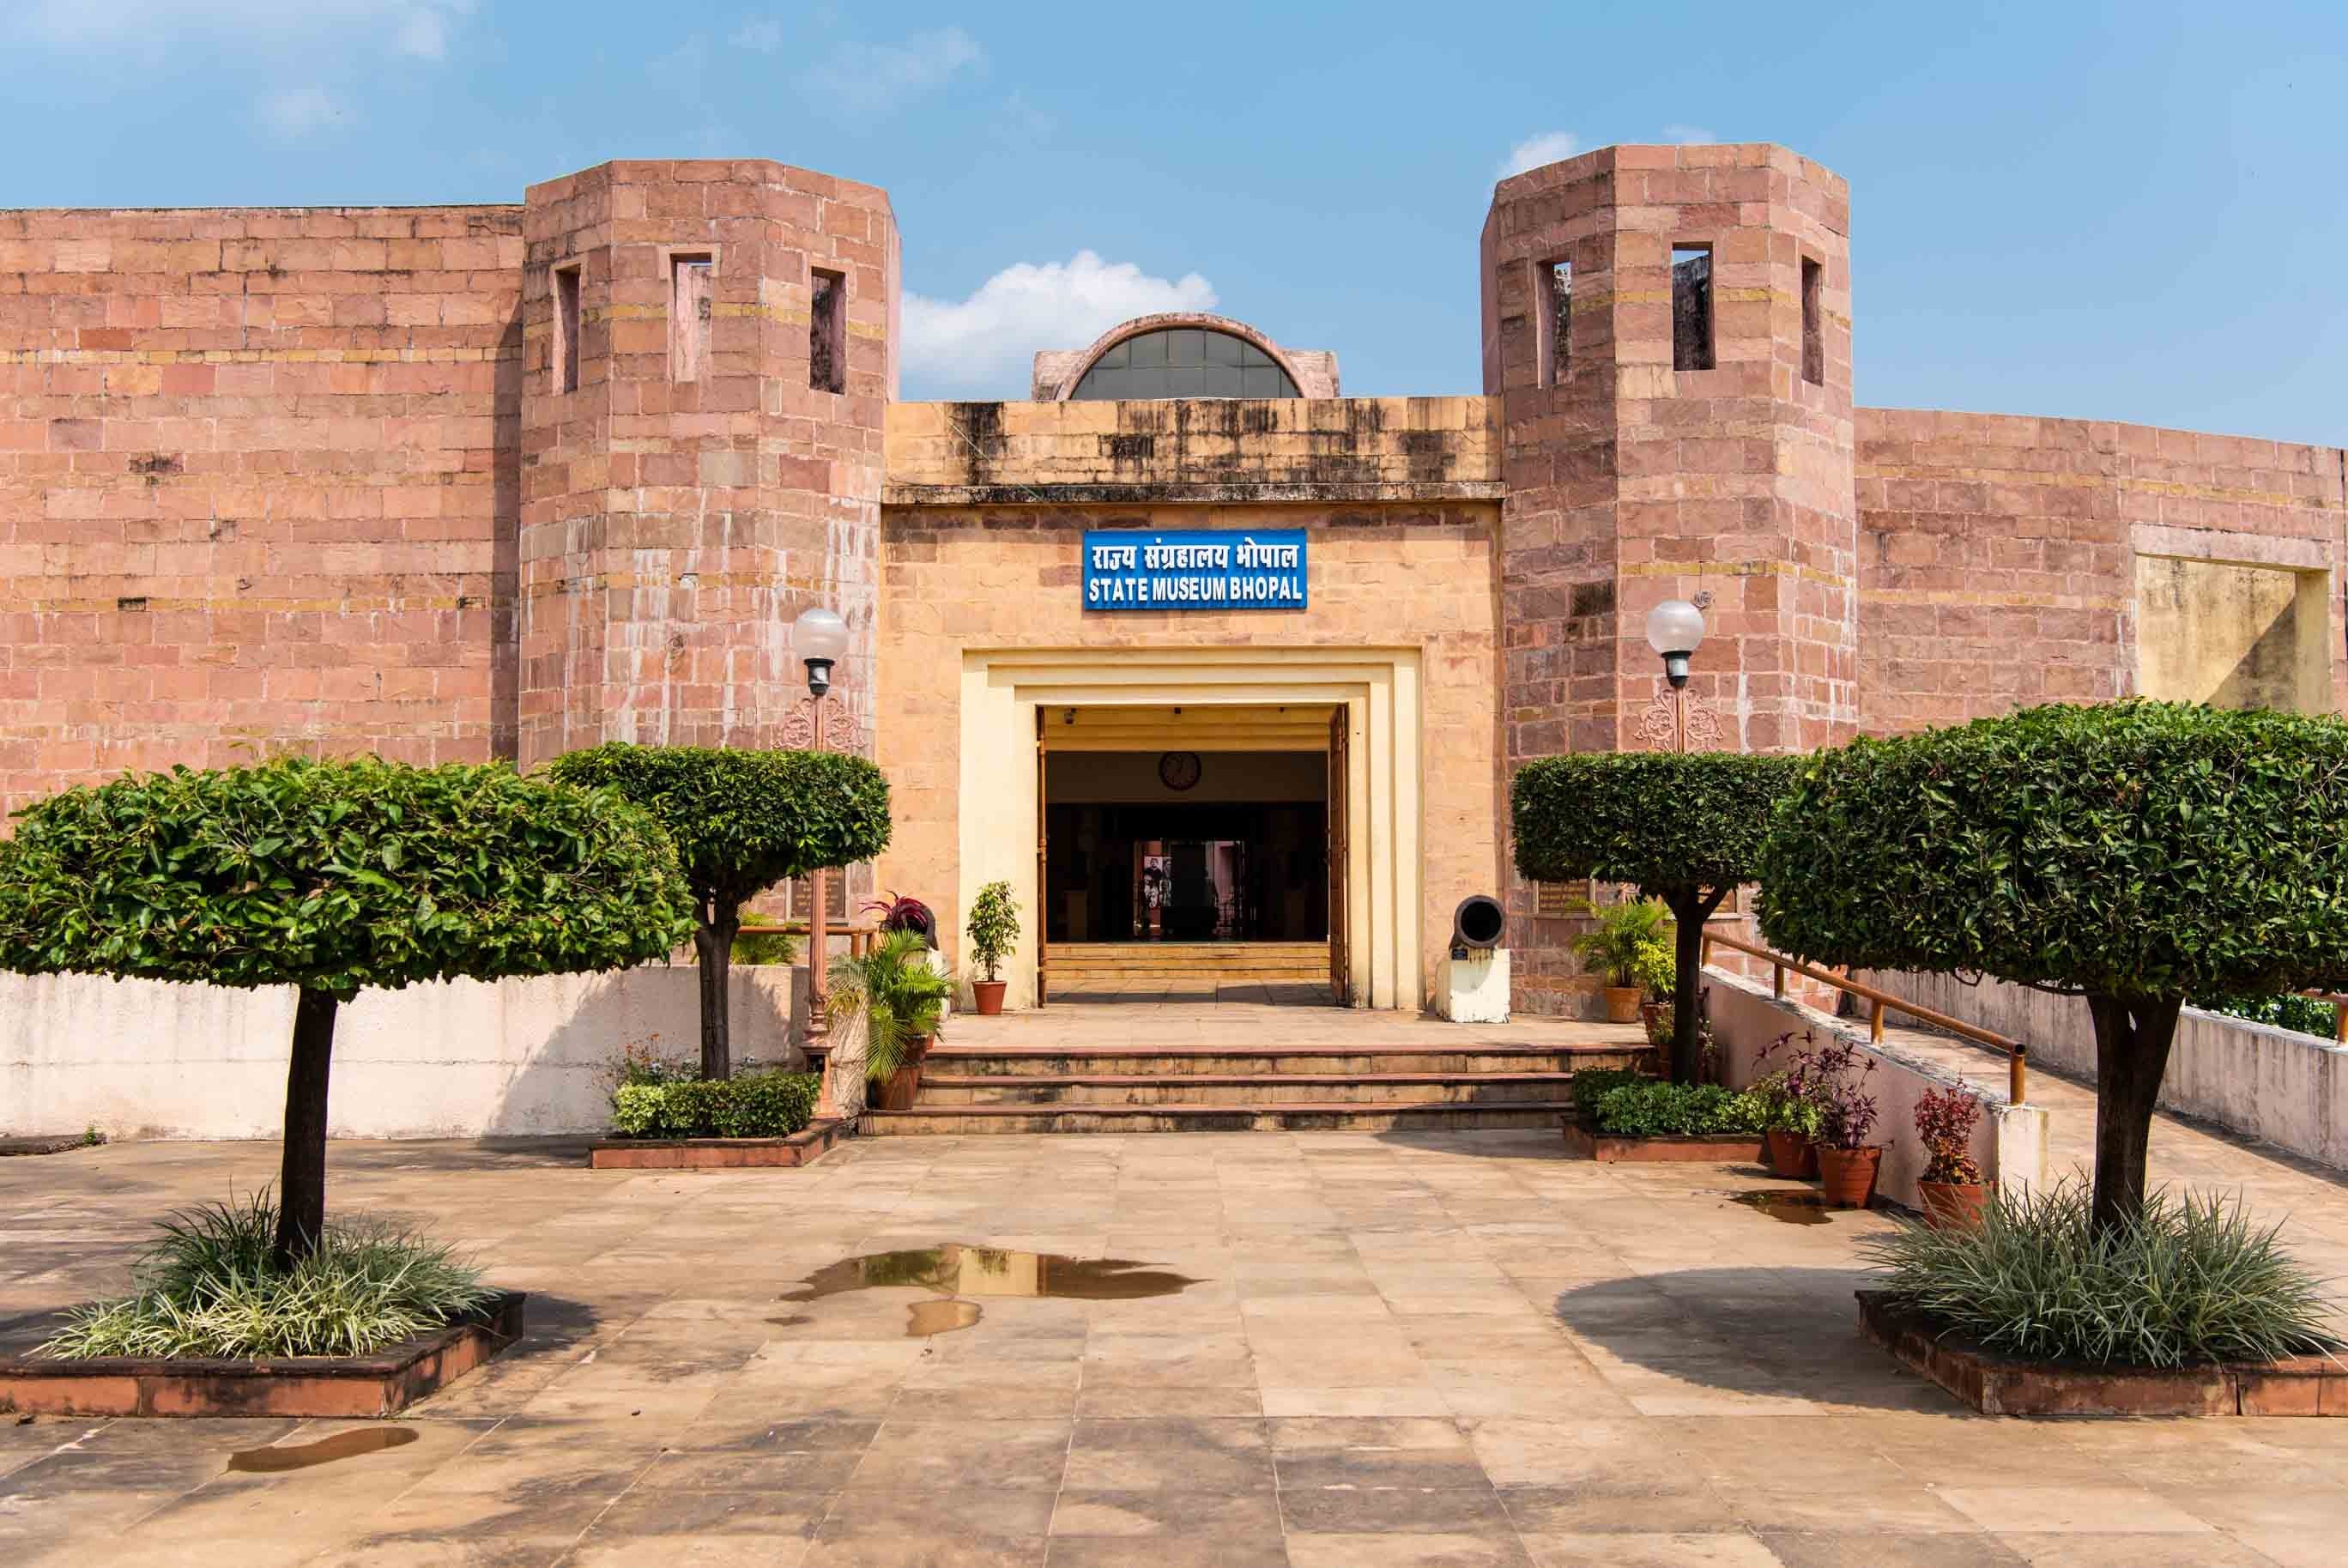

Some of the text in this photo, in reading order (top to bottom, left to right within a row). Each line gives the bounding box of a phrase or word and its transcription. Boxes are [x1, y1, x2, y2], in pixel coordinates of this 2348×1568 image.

[1092, 536, 1300, 570] राज्य संग्रहालय भोपाल
[1089, 576, 1303, 602] STATE MUSEUM BHOPAL
